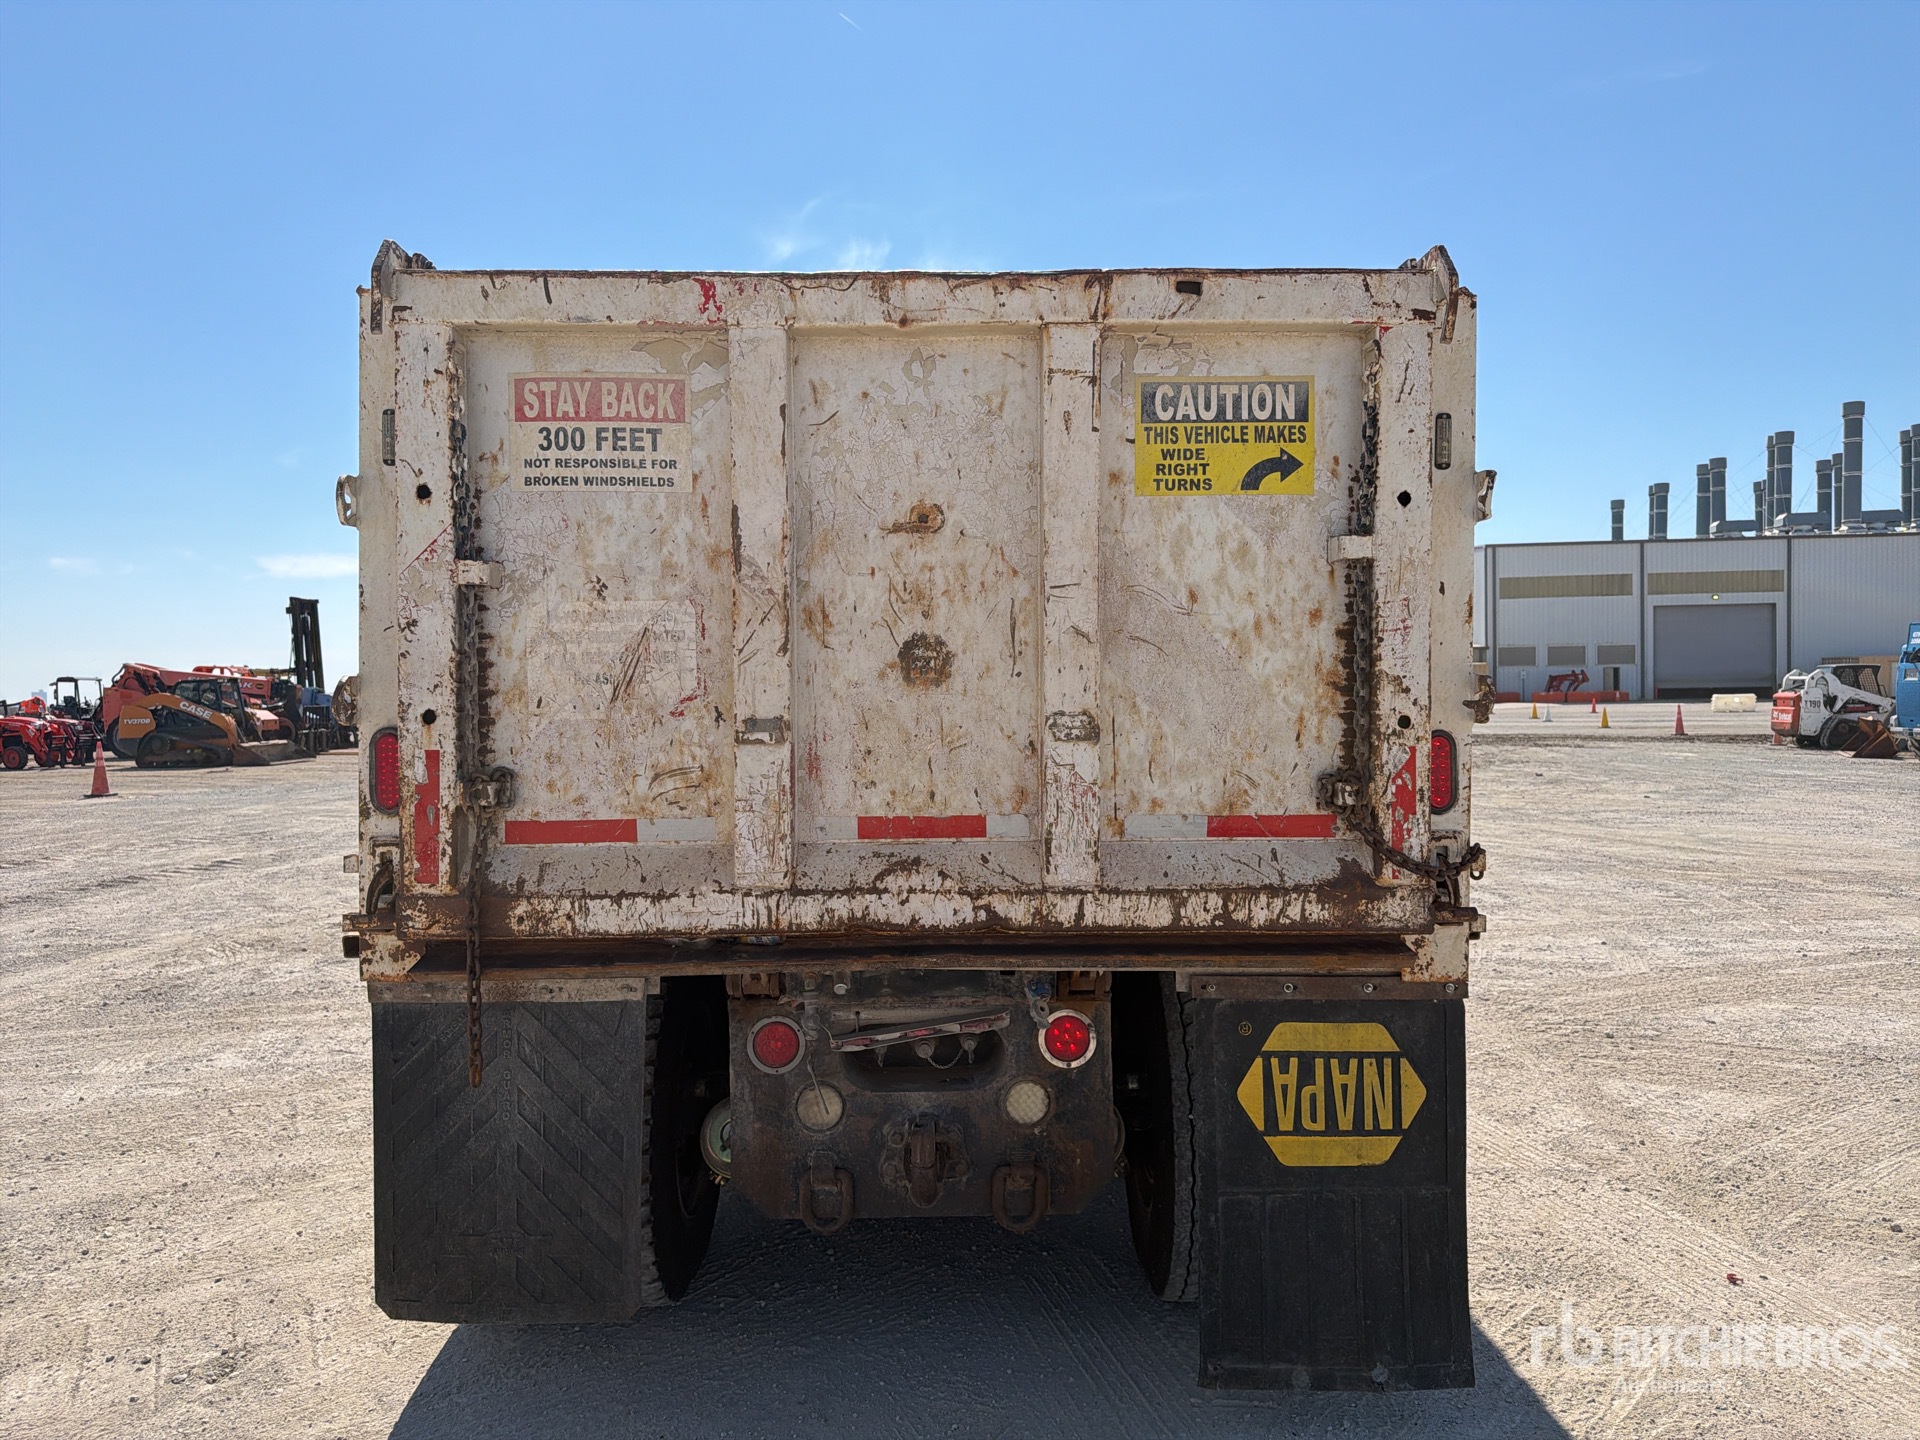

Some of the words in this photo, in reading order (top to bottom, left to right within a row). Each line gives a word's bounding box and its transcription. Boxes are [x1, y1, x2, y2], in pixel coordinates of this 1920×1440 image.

[523, 381, 591, 418] STAY
[601, 381, 676, 419] BACK
[1154, 383, 1296, 421] CAUTION
[537, 426, 586, 452] 300
[595, 427, 663, 452] FEET
[1143, 425, 1179, 445] THIS
[1183, 425, 1249, 444] VEHICLE
[1254, 424, 1307, 444] MAKES
[1160, 447, 1206, 461] WIDE
[523, 458, 551, 469] NOT
[555, 458, 647, 470] RESPONSIBLE
[651, 458, 678, 470] FOR
[1155, 462, 1210, 476] RIGHT
[523, 476, 579, 487] BROKEN
[583, 476, 675, 487] WINDSHIELDS
[1152, 478, 1213, 492] TURNS
[179, 701, 213, 720] CASE
[1270, 1057, 1394, 1132] NAPA
